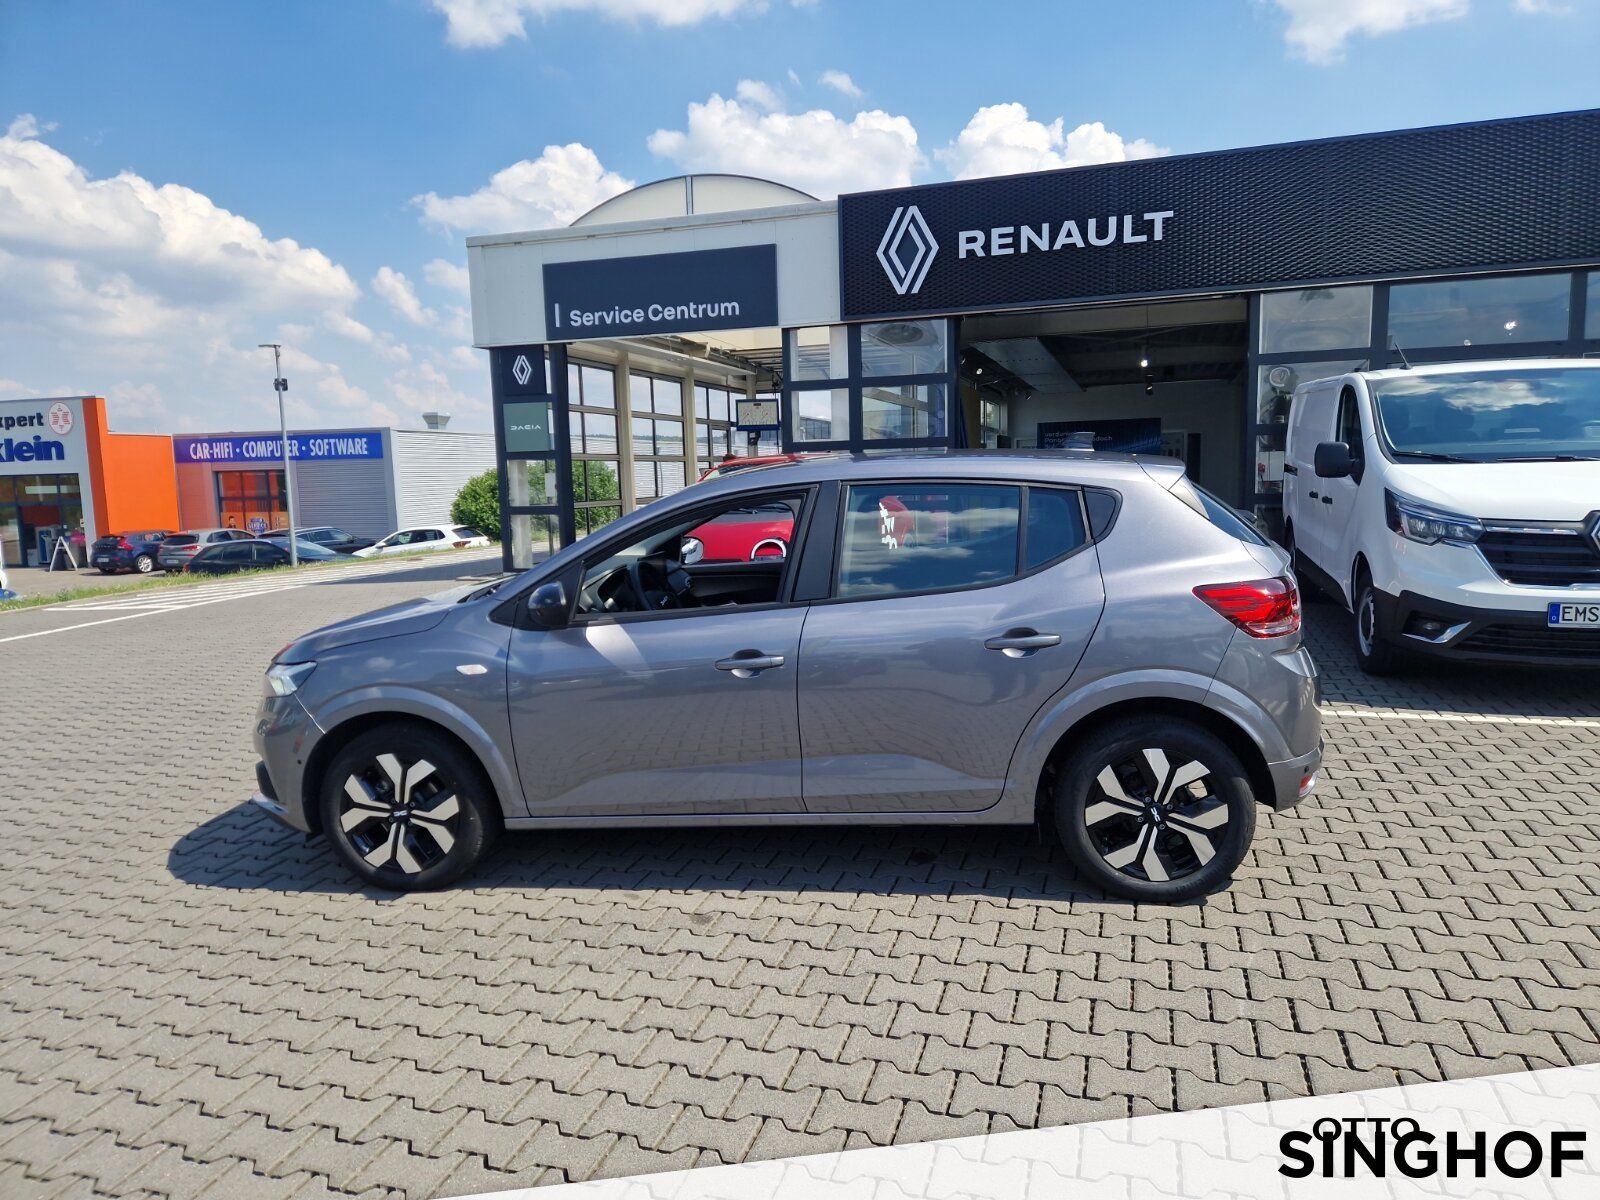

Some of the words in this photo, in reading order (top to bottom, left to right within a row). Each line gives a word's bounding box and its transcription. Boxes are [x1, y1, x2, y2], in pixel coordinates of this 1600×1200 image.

[958, 210, 1174, 260] RENAULT
[569, 305, 645, 328] Service
[648, 301, 740, 322] Centrum
[189, 441, 234, 460] CAR-HIFI
[309, 437, 368, 456] SOFTWARE
[1562, 606, 1599, 622] EMS
